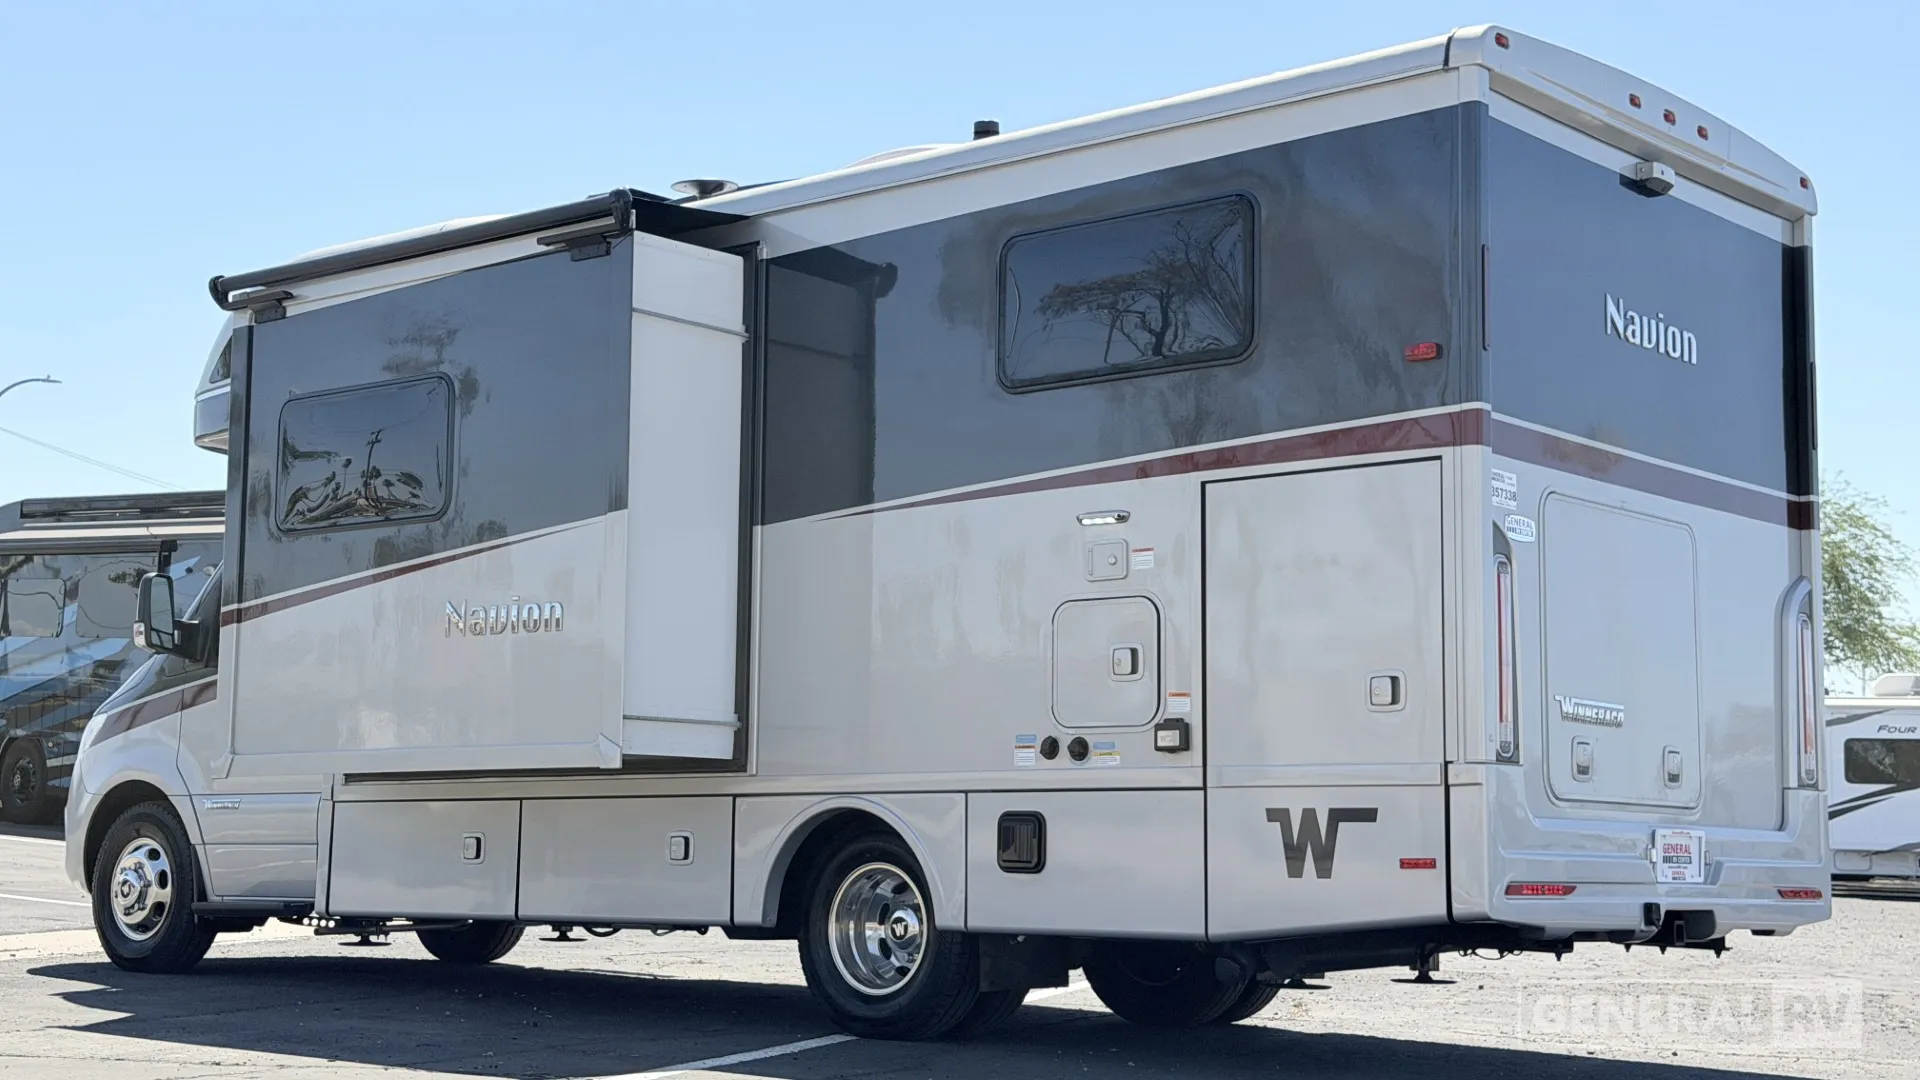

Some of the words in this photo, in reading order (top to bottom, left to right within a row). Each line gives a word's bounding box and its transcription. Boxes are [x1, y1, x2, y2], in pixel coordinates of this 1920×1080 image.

[1604, 292, 1697, 365] Navion
[1506, 515, 1534, 530] GENERAL
[445, 596, 564, 638] Navion
[1877, 725, 1917, 734] FOUR
[1265, 808, 1378, 879] W
[1662, 843, 1692, 855] GENERAL
[892, 921, 907, 937] W
